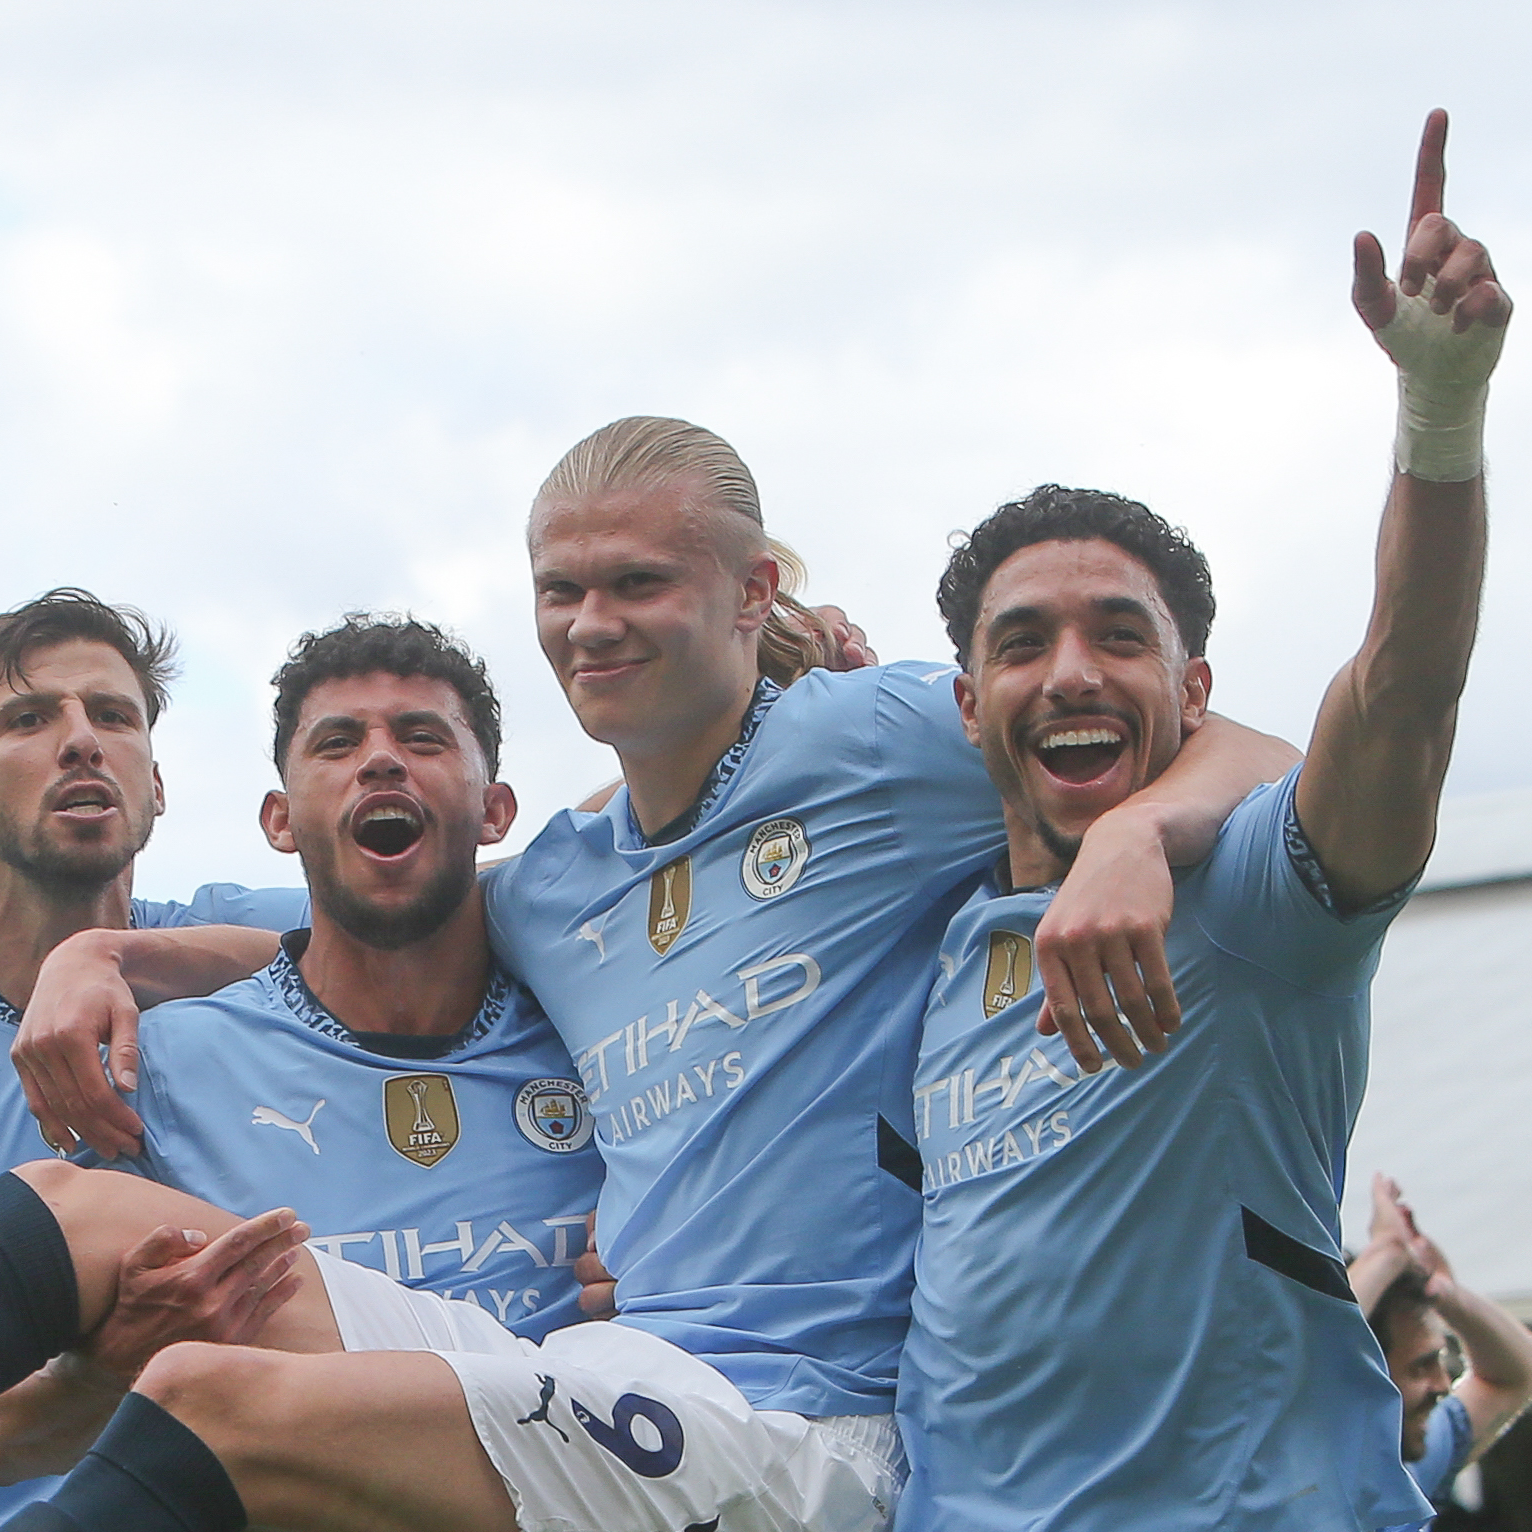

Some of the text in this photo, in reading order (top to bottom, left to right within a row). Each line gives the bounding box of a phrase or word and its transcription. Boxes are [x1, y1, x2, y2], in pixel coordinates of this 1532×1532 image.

[750, 821, 801, 854] MANCHESTER
[762, 884, 784, 896] CITY
[656, 919, 677, 934] FIFA
[578, 952, 822, 1106] ETIHAD
[519, 1080, 589, 1105] MANCHESTER
[609, 1051, 745, 1147] AIRWAYS
[915, 1047, 1120, 1141] TIHA
[408, 1132, 443, 1146] FIFA
[548, 1142, 573, 1151] CITY
